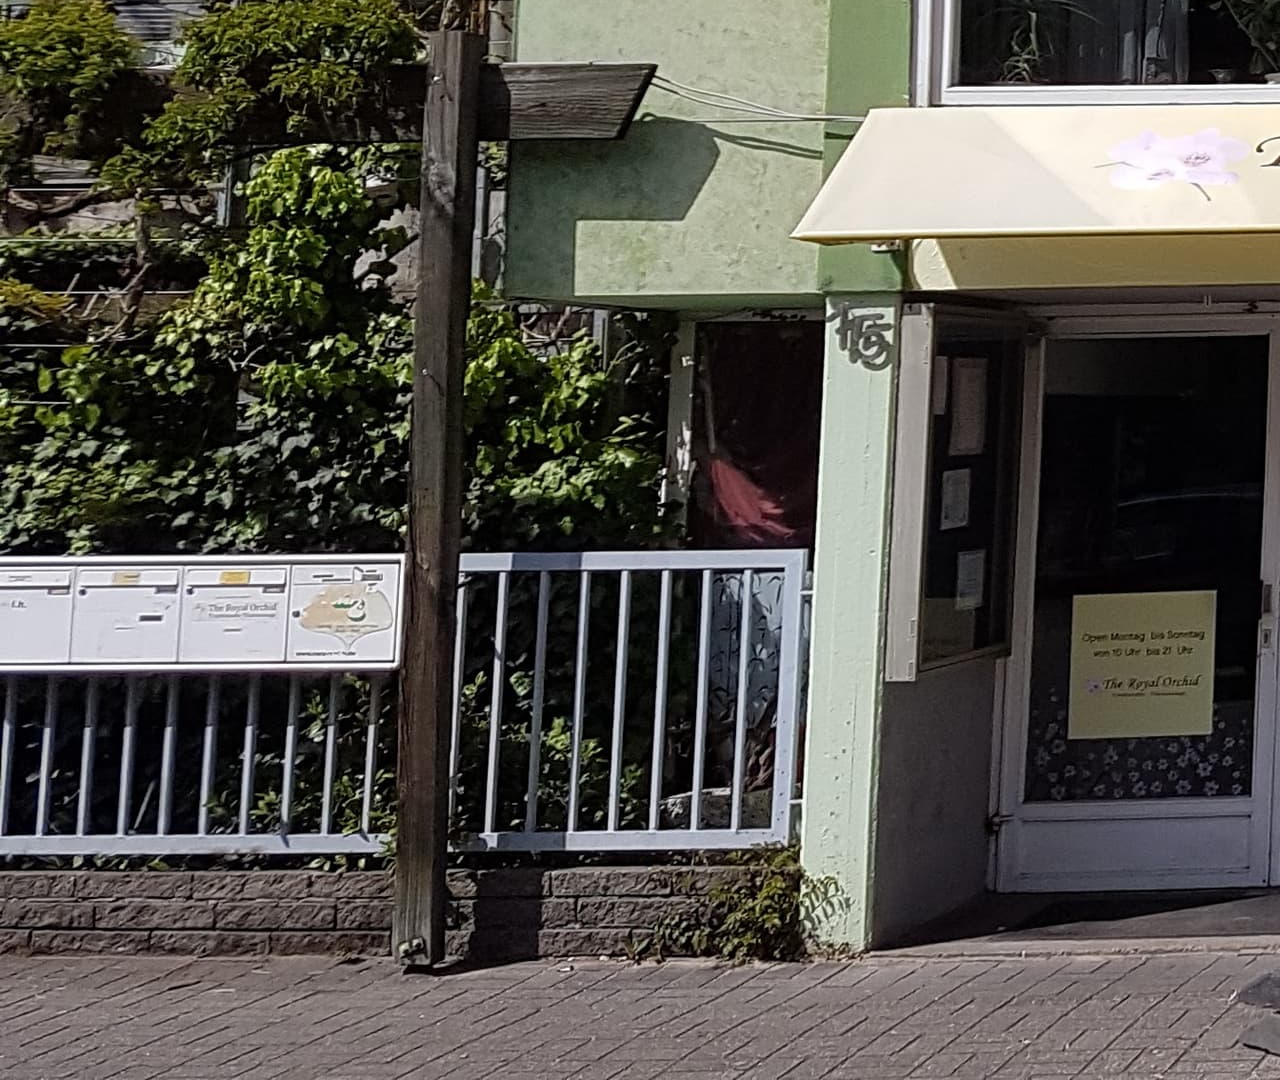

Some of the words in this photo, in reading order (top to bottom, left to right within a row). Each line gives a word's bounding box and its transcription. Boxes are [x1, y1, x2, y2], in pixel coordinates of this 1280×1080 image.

[1103, 678, 1123, 690] The
[1127, 676, 1162, 691] Royal
[1163, 675, 1203, 688] Orchid
